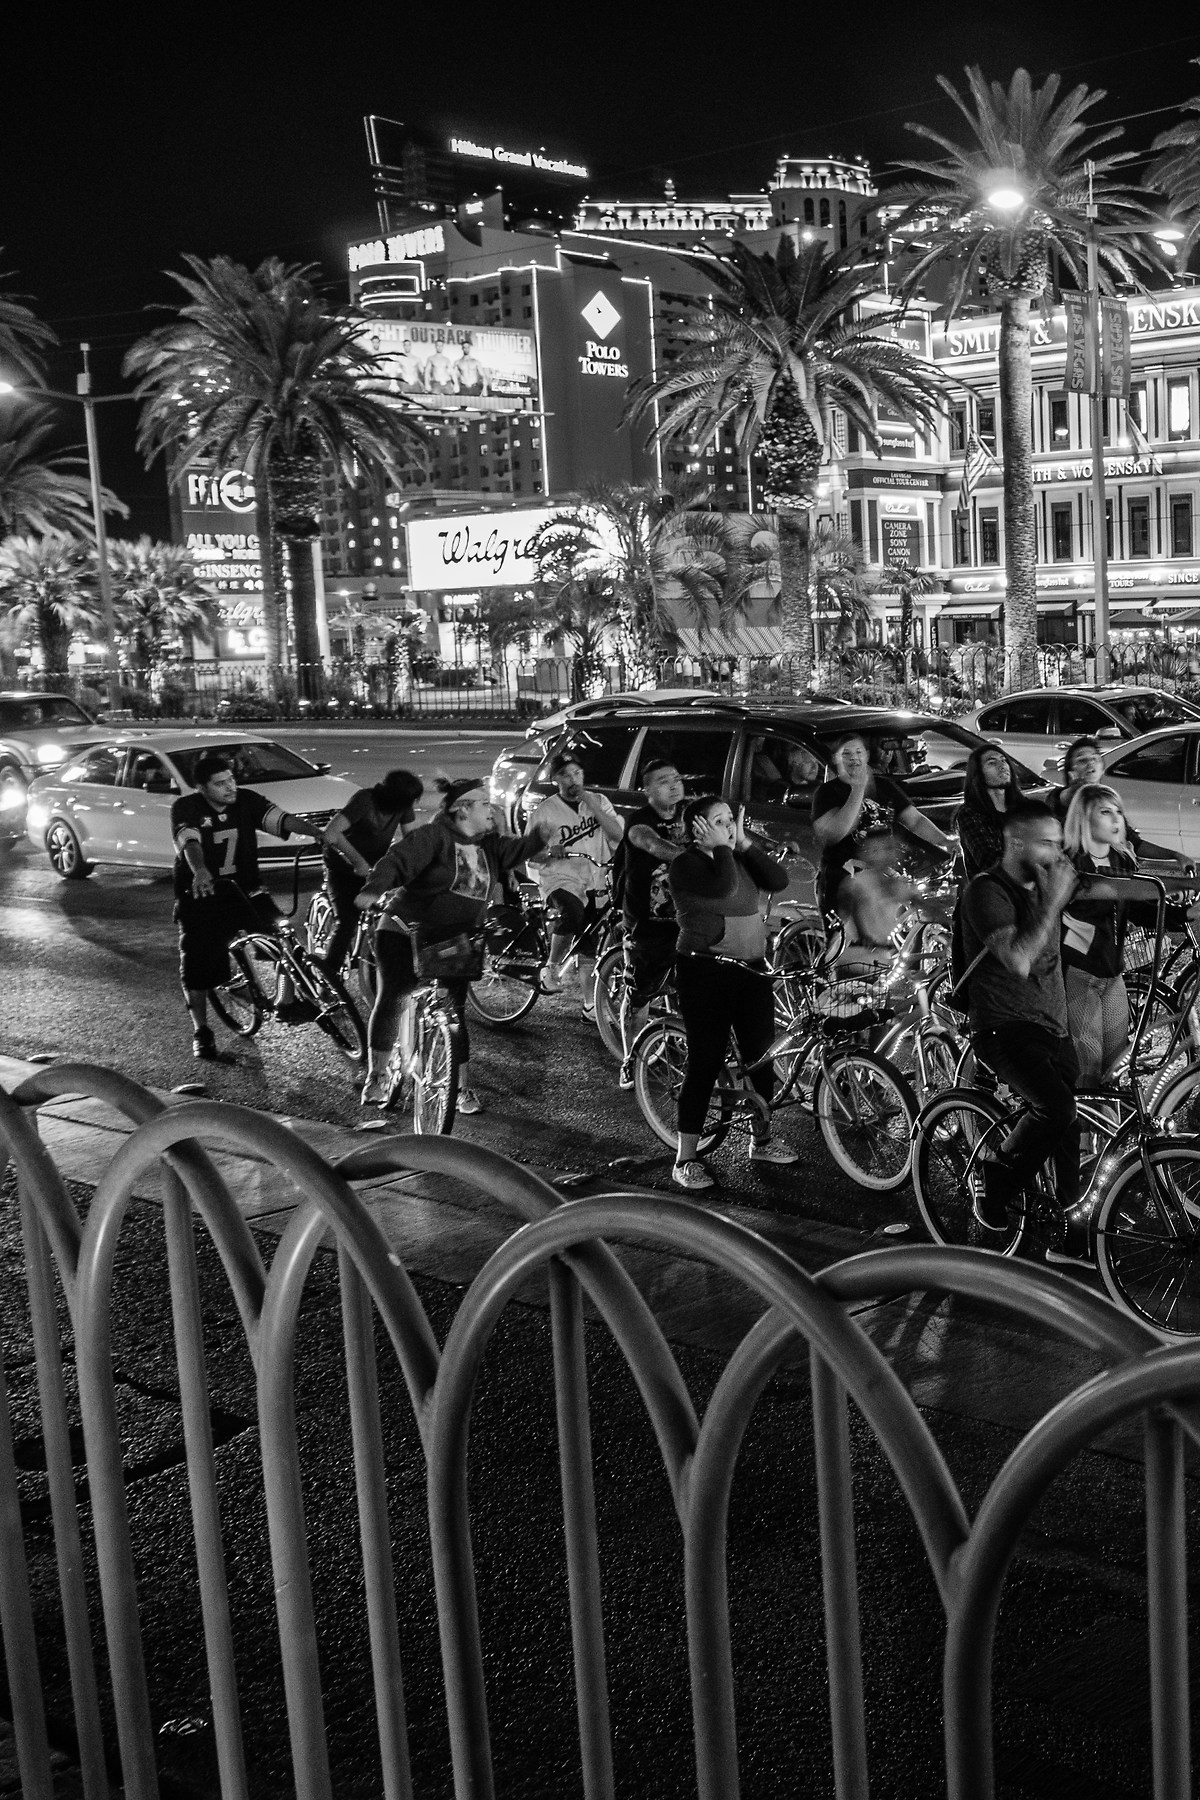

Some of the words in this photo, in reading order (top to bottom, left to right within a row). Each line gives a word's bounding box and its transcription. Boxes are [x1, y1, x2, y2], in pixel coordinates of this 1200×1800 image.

[450, 138, 493, 160] Hilton
[493, 146, 532, 167] Grand
[532, 153, 588, 178] Vacations
[1070, 304, 1085, 335] LAS
[475, 332, 531, 353] THUNDER
[949, 327, 1002, 356] SMIT
[1033, 321, 1053, 346] &
[1108, 312, 1125, 362] VEGAS
[585, 340, 621, 360] POLO
[578, 356, 629, 378] TOWERS
[1071, 338, 1085, 390] VEGAS
[1109, 364, 1124, 396] LAS
[1057, 467, 1067, 481] &
[1071, 460, 1150, 480] WOENSKY
[872, 476, 896, 485] OFFICIAL
[895, 477, 909, 486] TOUR
[909, 478, 929, 487] CENTER
[884, 521, 912, 531] CAMERA
[889, 530, 908, 538] ZONE
[186, 533, 216, 549] ALL
[215, 533, 246, 550] YOU
[438, 525, 538, 574] Walgre
[887, 547, 911, 556] CANON
[889, 538, 908, 547] SONY
[192, 564, 262, 578] GINSENG
[1167, 572, 1199, 584] SINCE
[1109, 579, 1134, 588] TOURS
[212, 827, 239, 876] 7
